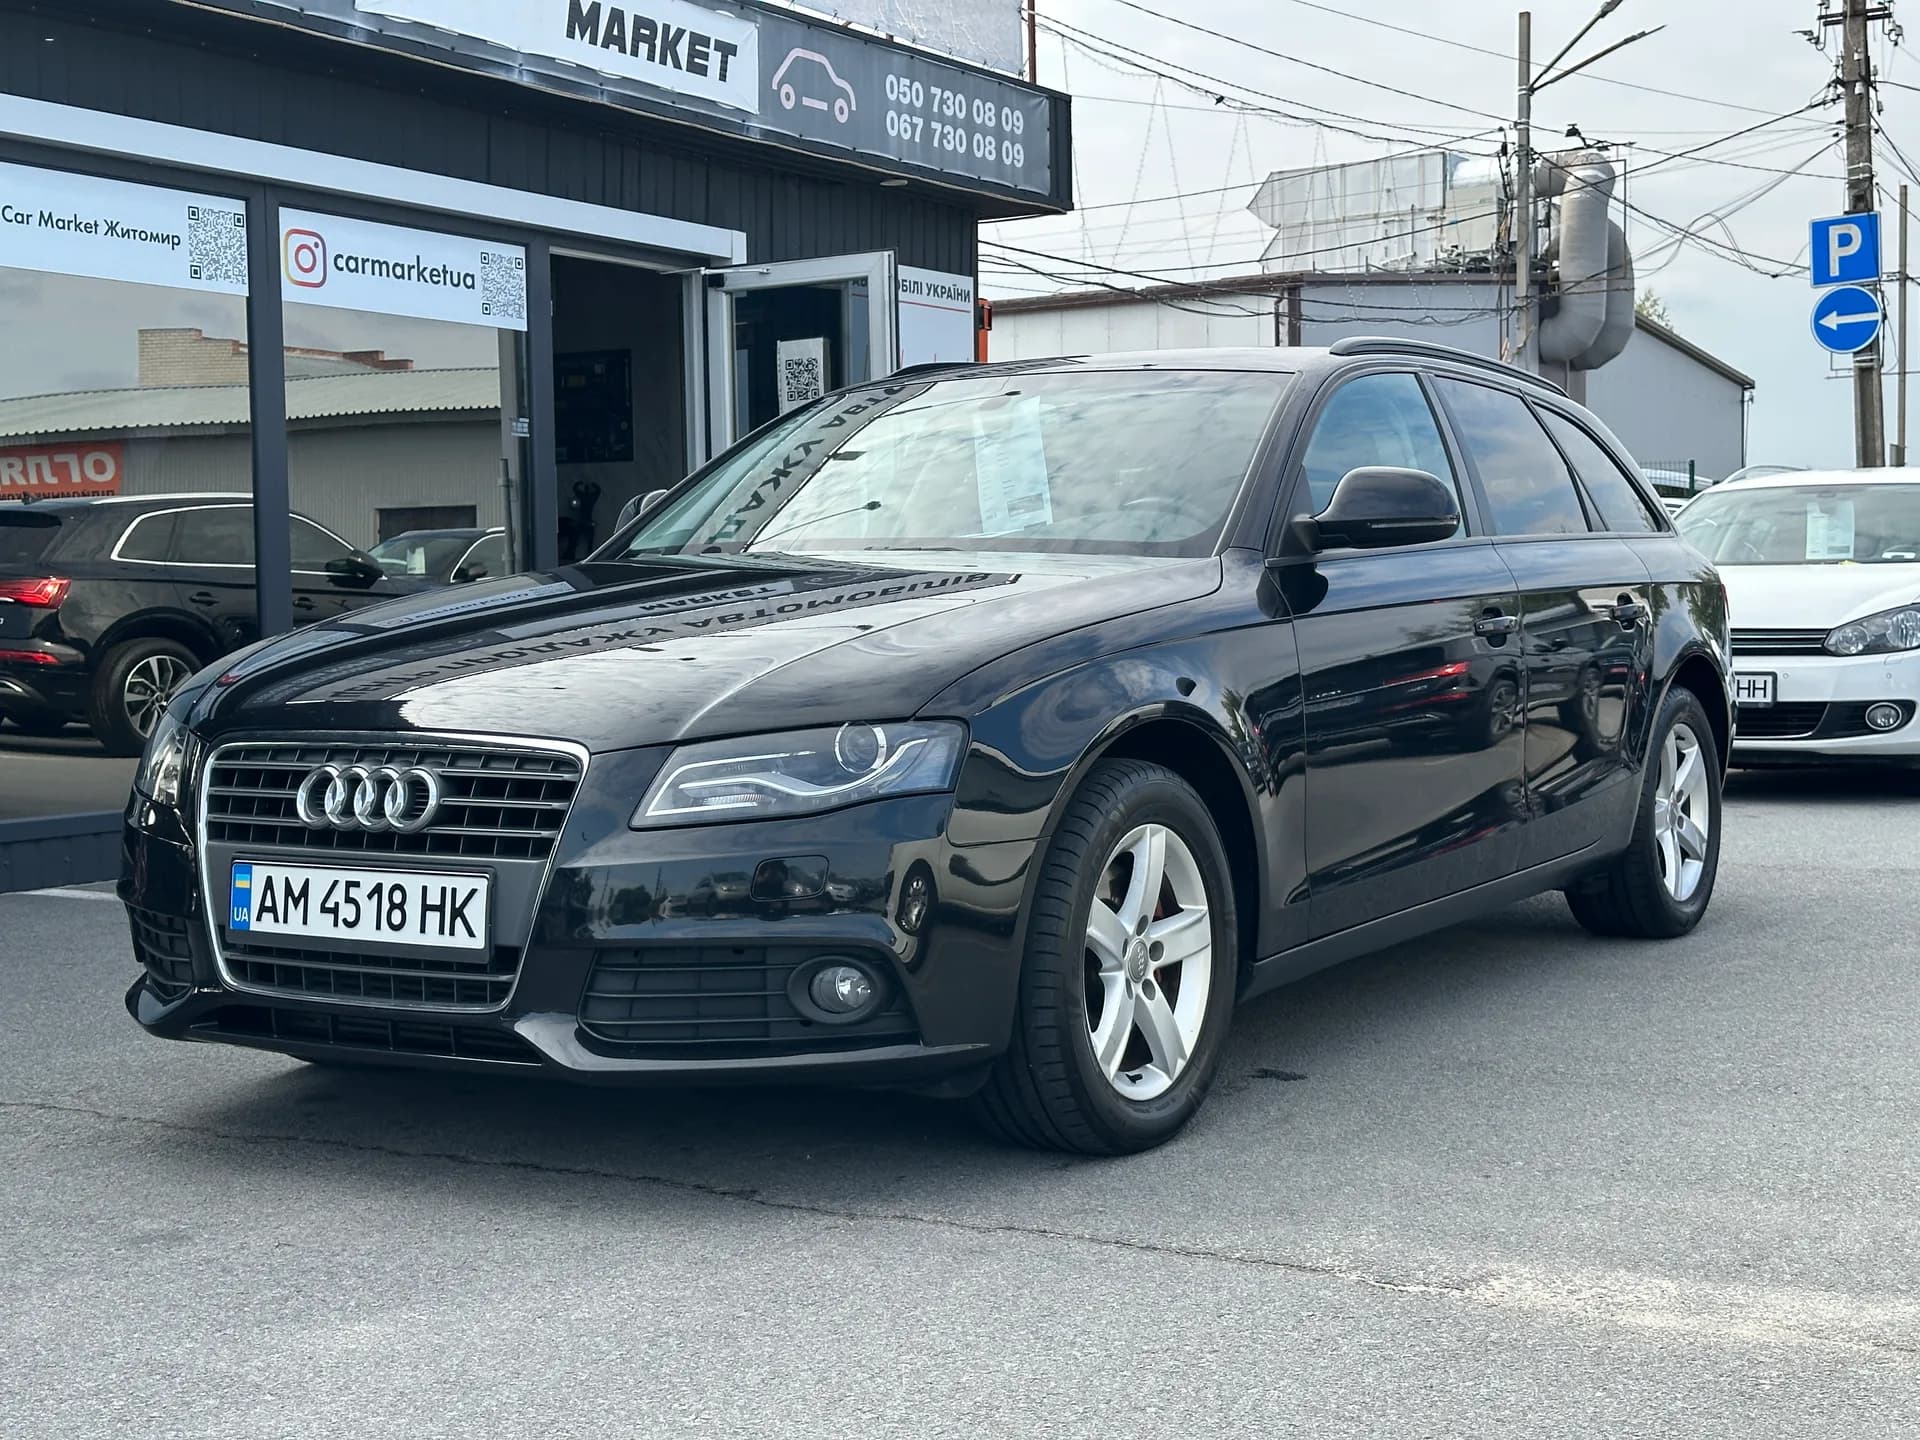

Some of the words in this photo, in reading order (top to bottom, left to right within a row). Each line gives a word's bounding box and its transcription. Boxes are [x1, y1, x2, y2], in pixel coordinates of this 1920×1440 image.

[566, 0, 738, 83] MARKET
[885, 74, 924, 108] 050
[930, 86, 967, 120] 730
[972, 98, 996, 128] 08
[1001, 106, 1024, 135] 09
[886, 110, 924, 143] 067
[930, 121, 967, 154] 730
[972, 132, 996, 161] 08
[1001, 140, 1024, 168] 09
[1, 204, 33, 226] Car
[38, 210, 99, 235] Market
[103, 218, 181, 251] Житомир
[1828, 223, 1862, 277] P
[333, 252, 476, 290] carmarketua
[898, 278, 923, 296] БІЛІ
[926, 283, 971, 304] УКРАЇНИ
[1736, 679, 1767, 698] HH
[234, 907, 249, 922] UA
[255, 875, 310, 926] AM
[320, 879, 408, 932] 4518
[419, 885, 479, 938] HK
